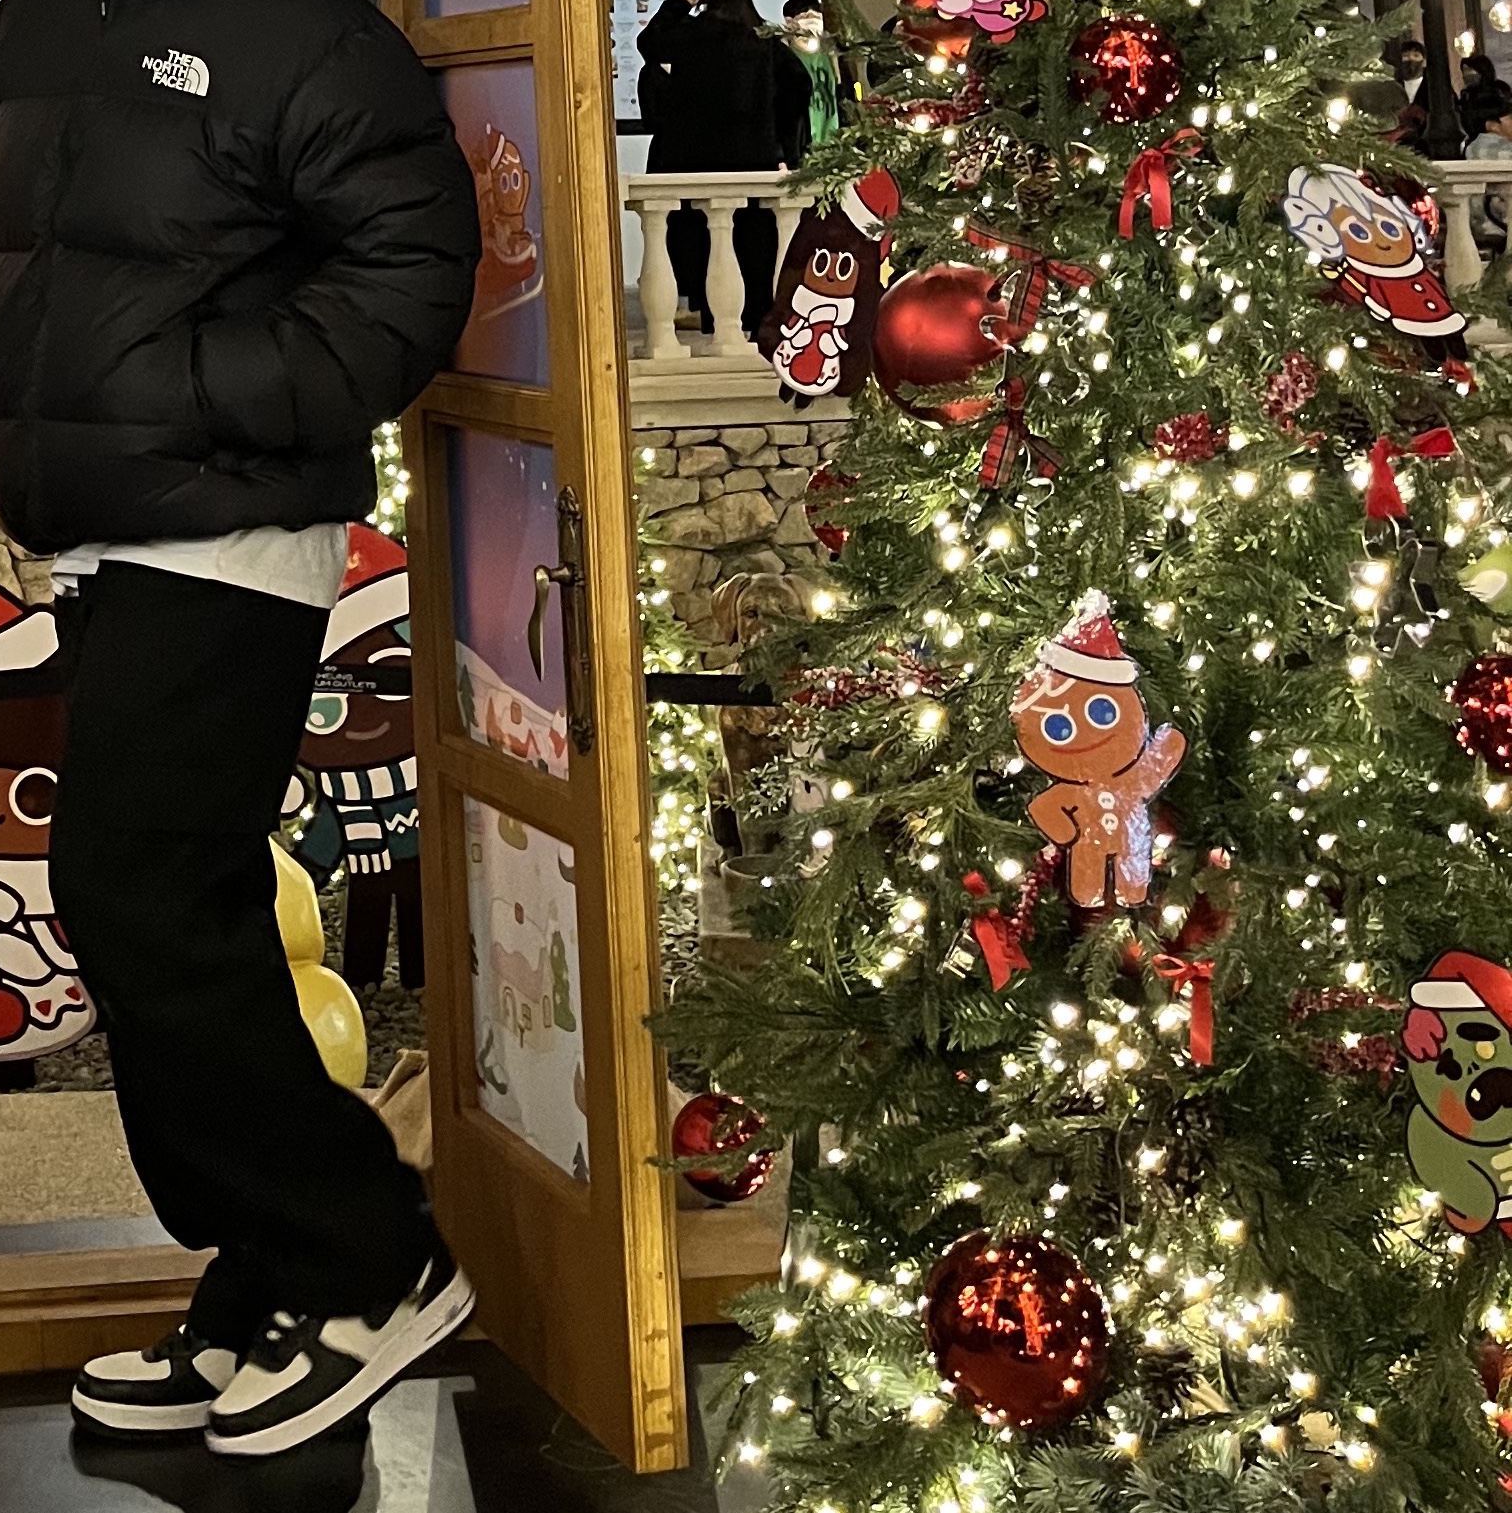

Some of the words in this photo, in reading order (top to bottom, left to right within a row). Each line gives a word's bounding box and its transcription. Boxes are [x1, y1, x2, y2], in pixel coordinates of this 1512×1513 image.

[141, 55, 189, 79] NORTH
[168, 48, 194, 67] THE
[152, 71, 186, 91] FACE
